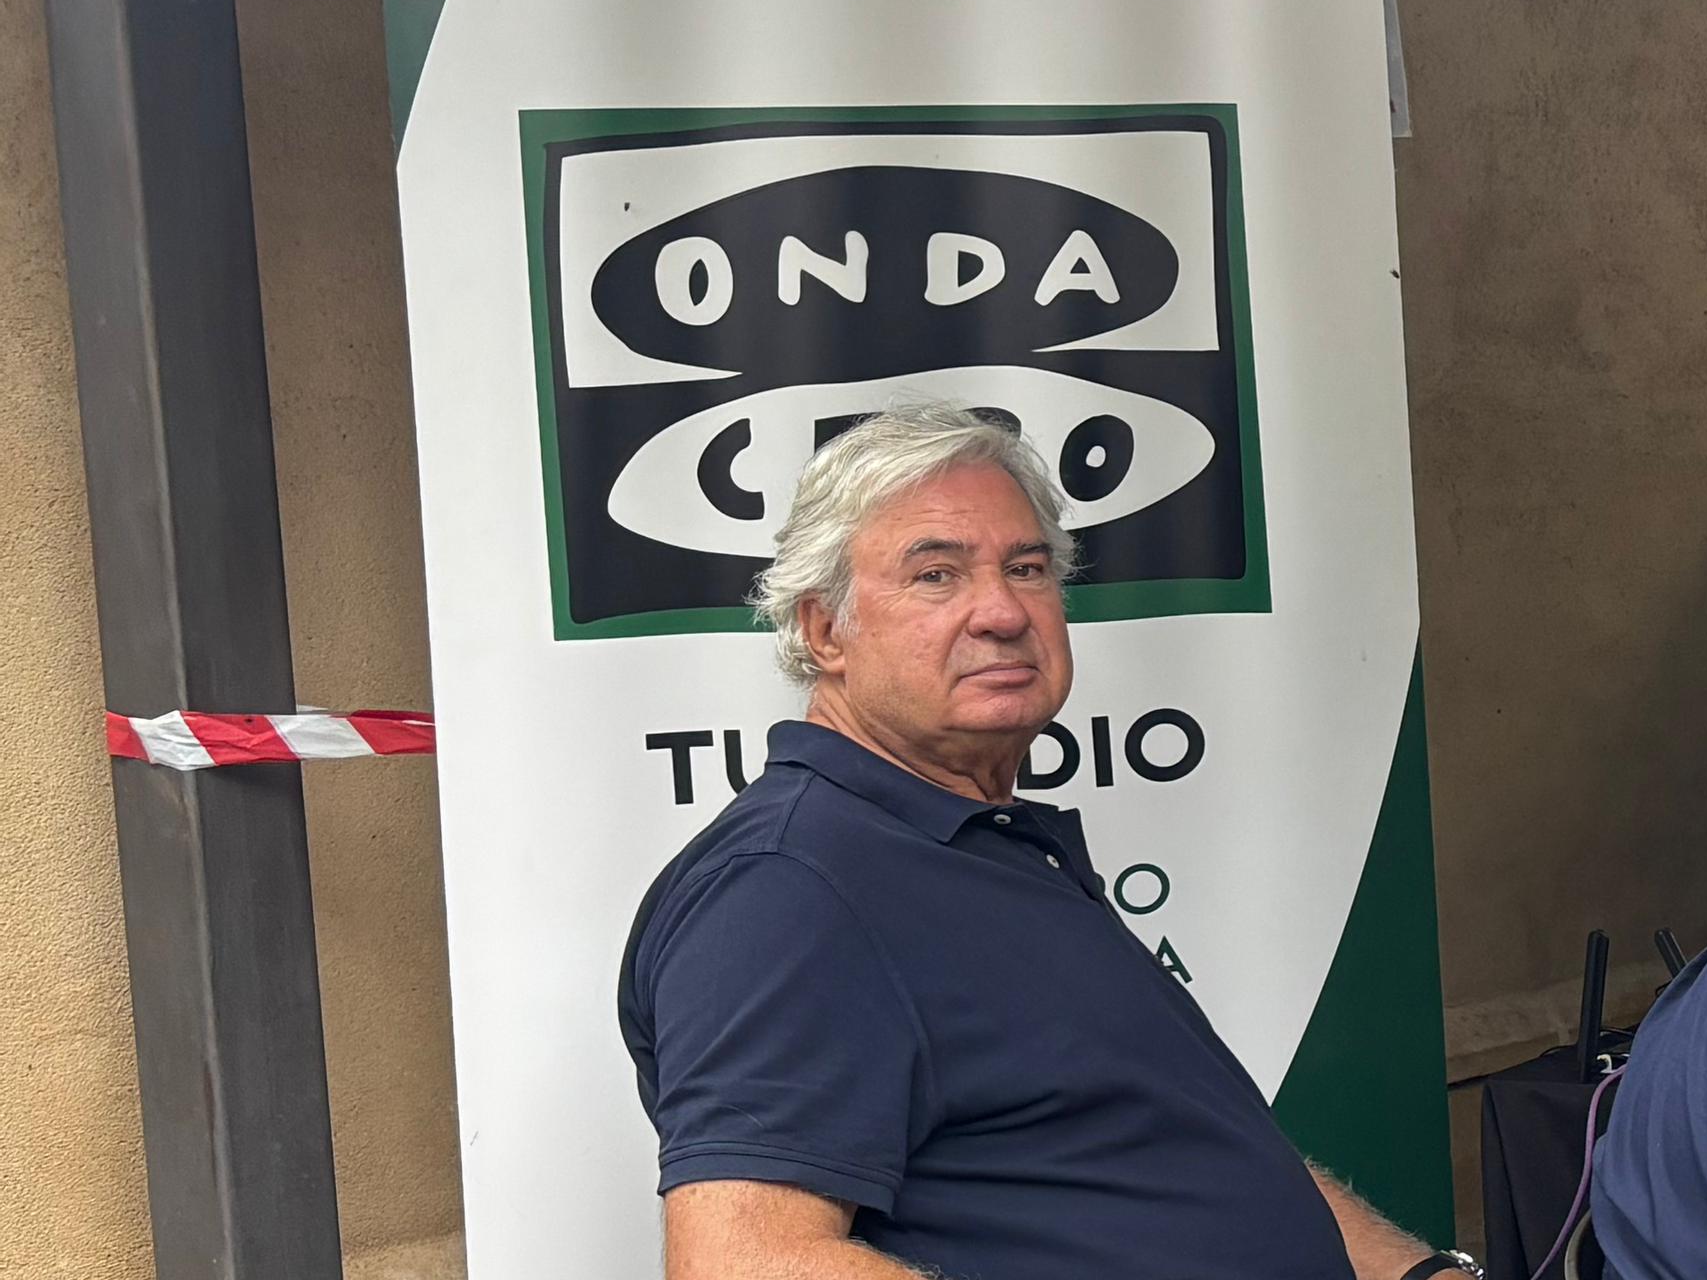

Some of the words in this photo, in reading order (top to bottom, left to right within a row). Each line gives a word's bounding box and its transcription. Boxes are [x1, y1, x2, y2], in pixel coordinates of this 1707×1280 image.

[655, 229, 1120, 327] ONDA
[696, 410, 1135, 521] CO
[1015, 708, 1205, 790] DIO
